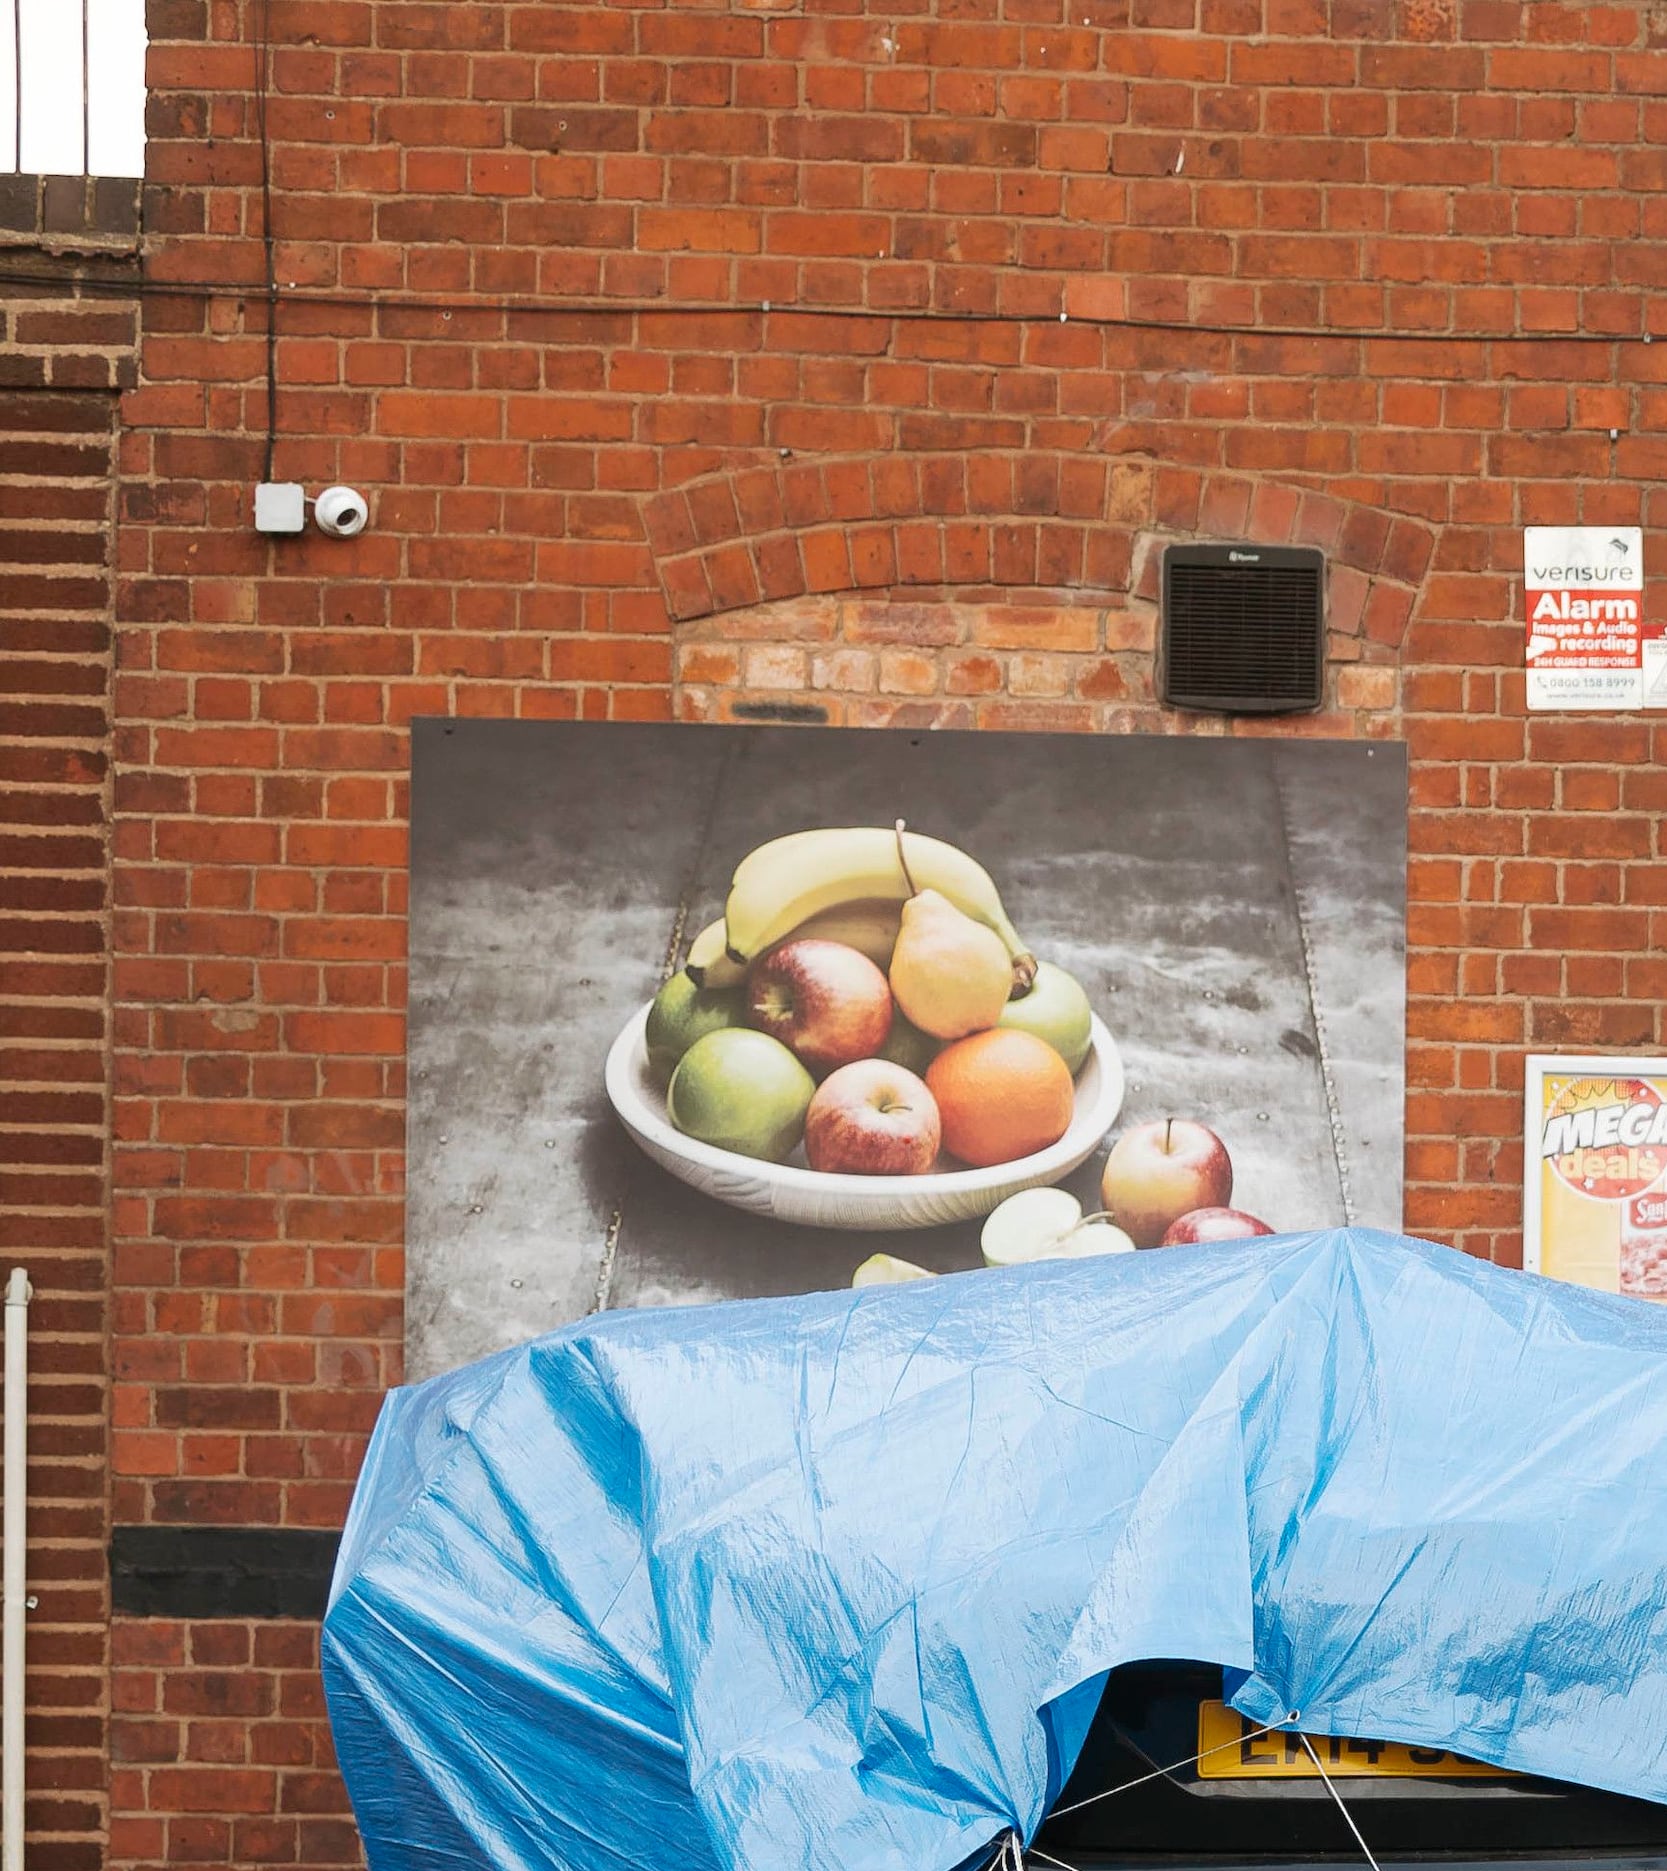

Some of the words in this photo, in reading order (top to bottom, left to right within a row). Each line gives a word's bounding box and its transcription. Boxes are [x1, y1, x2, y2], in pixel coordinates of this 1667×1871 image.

[1533, 567, 1633, 581] verisure
[1532, 591, 1637, 620] Alarm
[1532, 621, 1580, 638] Images
[1582, 621, 1595, 635] &
[1596, 621, 1638, 635] Audio
[1560, 635, 1638, 655] recording
[1560, 1148, 1660, 1180] deals
